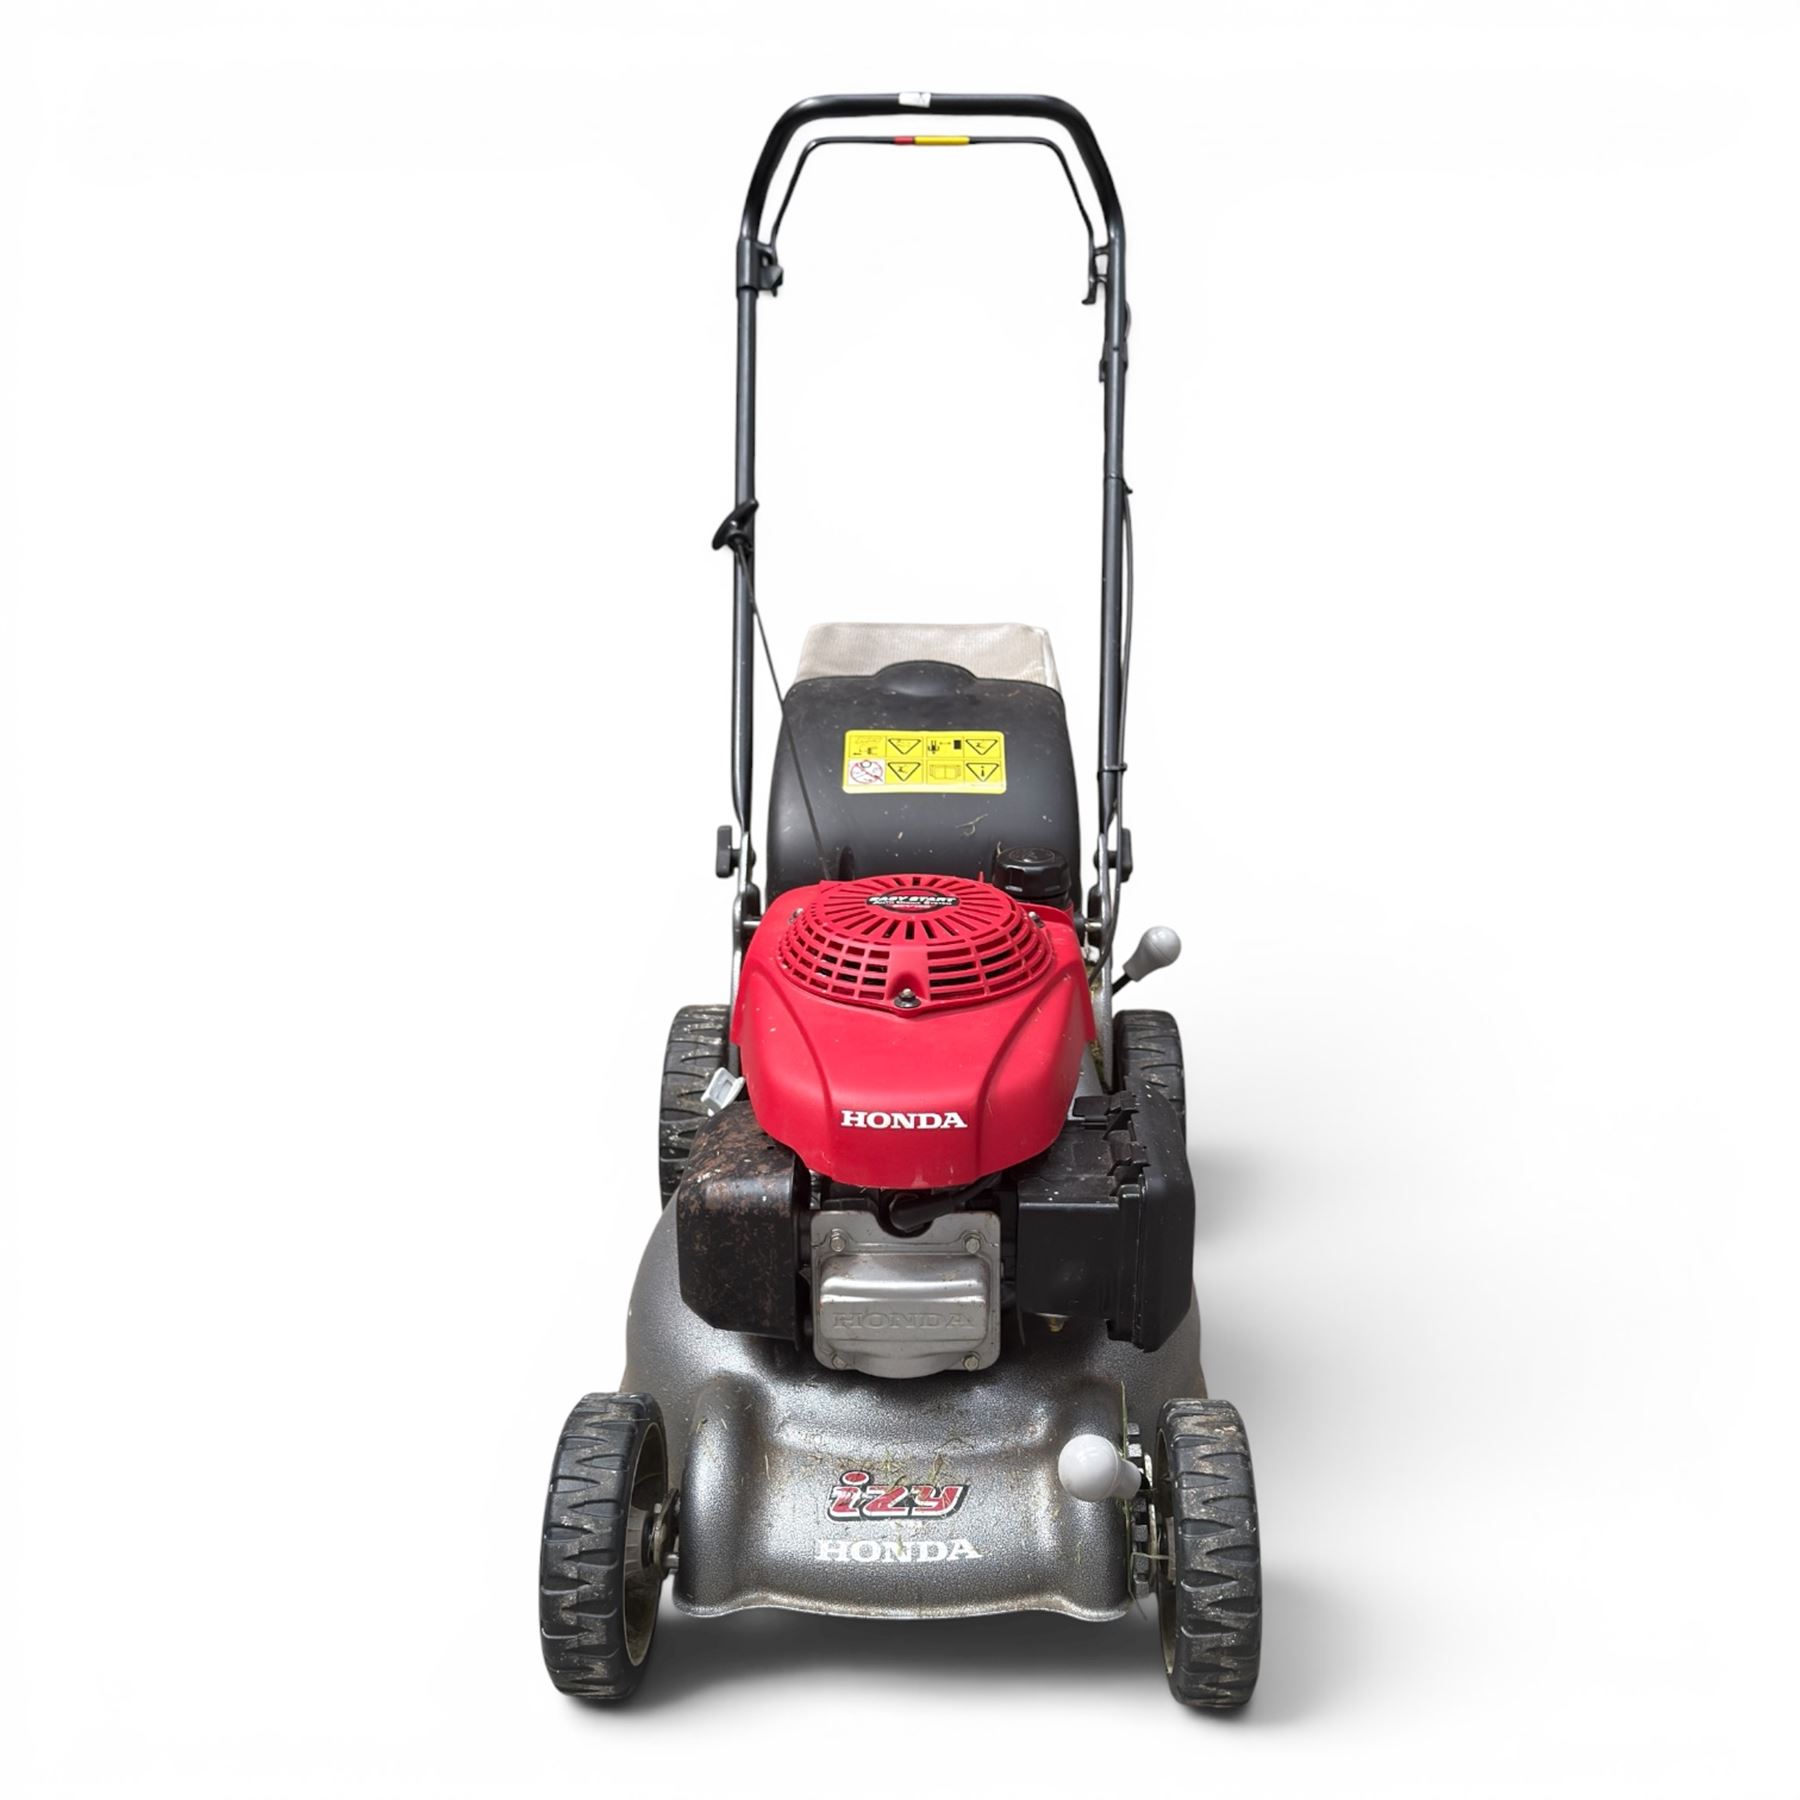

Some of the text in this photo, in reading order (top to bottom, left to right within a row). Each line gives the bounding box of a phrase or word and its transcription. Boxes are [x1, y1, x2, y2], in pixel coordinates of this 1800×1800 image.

[841, 1110, 968, 1129] HONDA
[832, 1312, 975, 1330] HONDA
[827, 1470, 969, 1521] izy
[814, 1538, 983, 1563] HONDA
